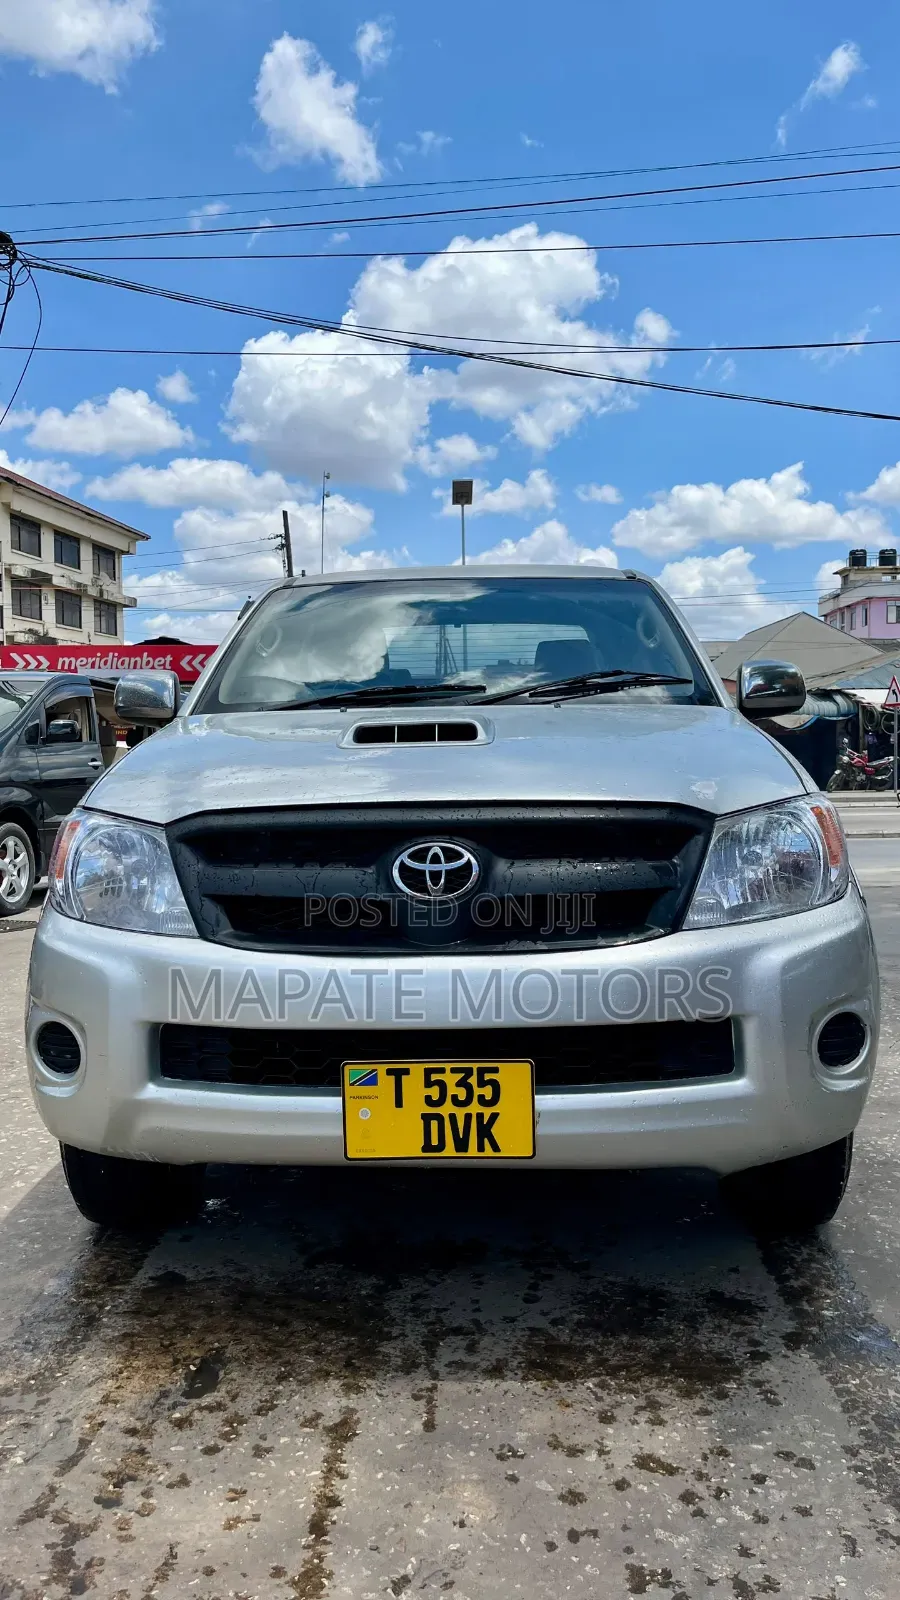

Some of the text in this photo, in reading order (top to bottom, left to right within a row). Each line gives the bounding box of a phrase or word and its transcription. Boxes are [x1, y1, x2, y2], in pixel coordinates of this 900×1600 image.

[57, 652, 173, 670] meridianbet
[385, 1066, 502, 1108] T 535
[420, 1112, 502, 1153] DVK
